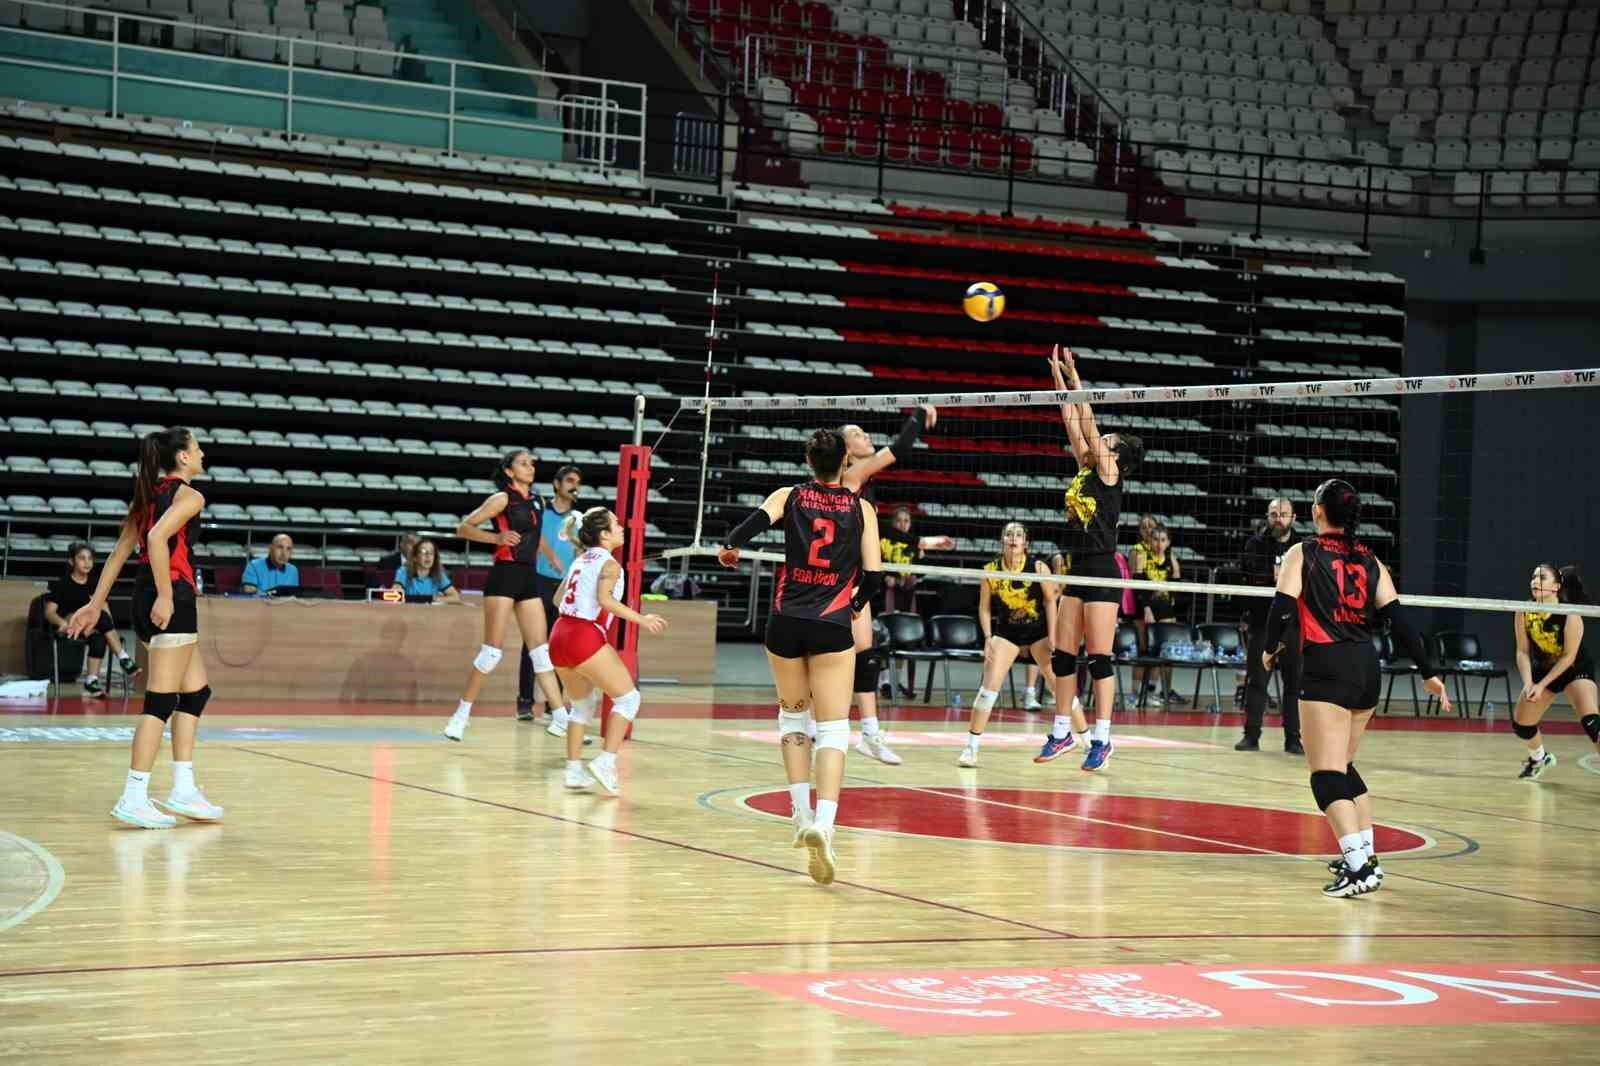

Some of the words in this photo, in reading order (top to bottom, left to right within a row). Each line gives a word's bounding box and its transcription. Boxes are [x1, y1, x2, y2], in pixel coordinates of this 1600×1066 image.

[984, 395, 996, 404] TVF
[1019, 394, 1031, 402] TVF
[1056, 393, 1068, 401] TVF
[1092, 392, 1106, 400] TVF
[1132, 390, 1146, 399] TVF
[1172, 389, 1187, 398] TVF
[1214, 387, 1229, 397] TVF
[1259, 386, 1275, 396] TVF
[1306, 384, 1323, 394] TVF
[1354, 382, 1372, 393] TVF
[1405, 380, 1423, 391] TVF
[1459, 377, 1477, 388] TVF
[1515, 375, 1535, 386] TVF
[1574, 371, 1596, 383] TVF
[808, 518, 834, 569] 2
[566, 570, 581, 604] 5
[1331, 559, 1367, 609] 13
